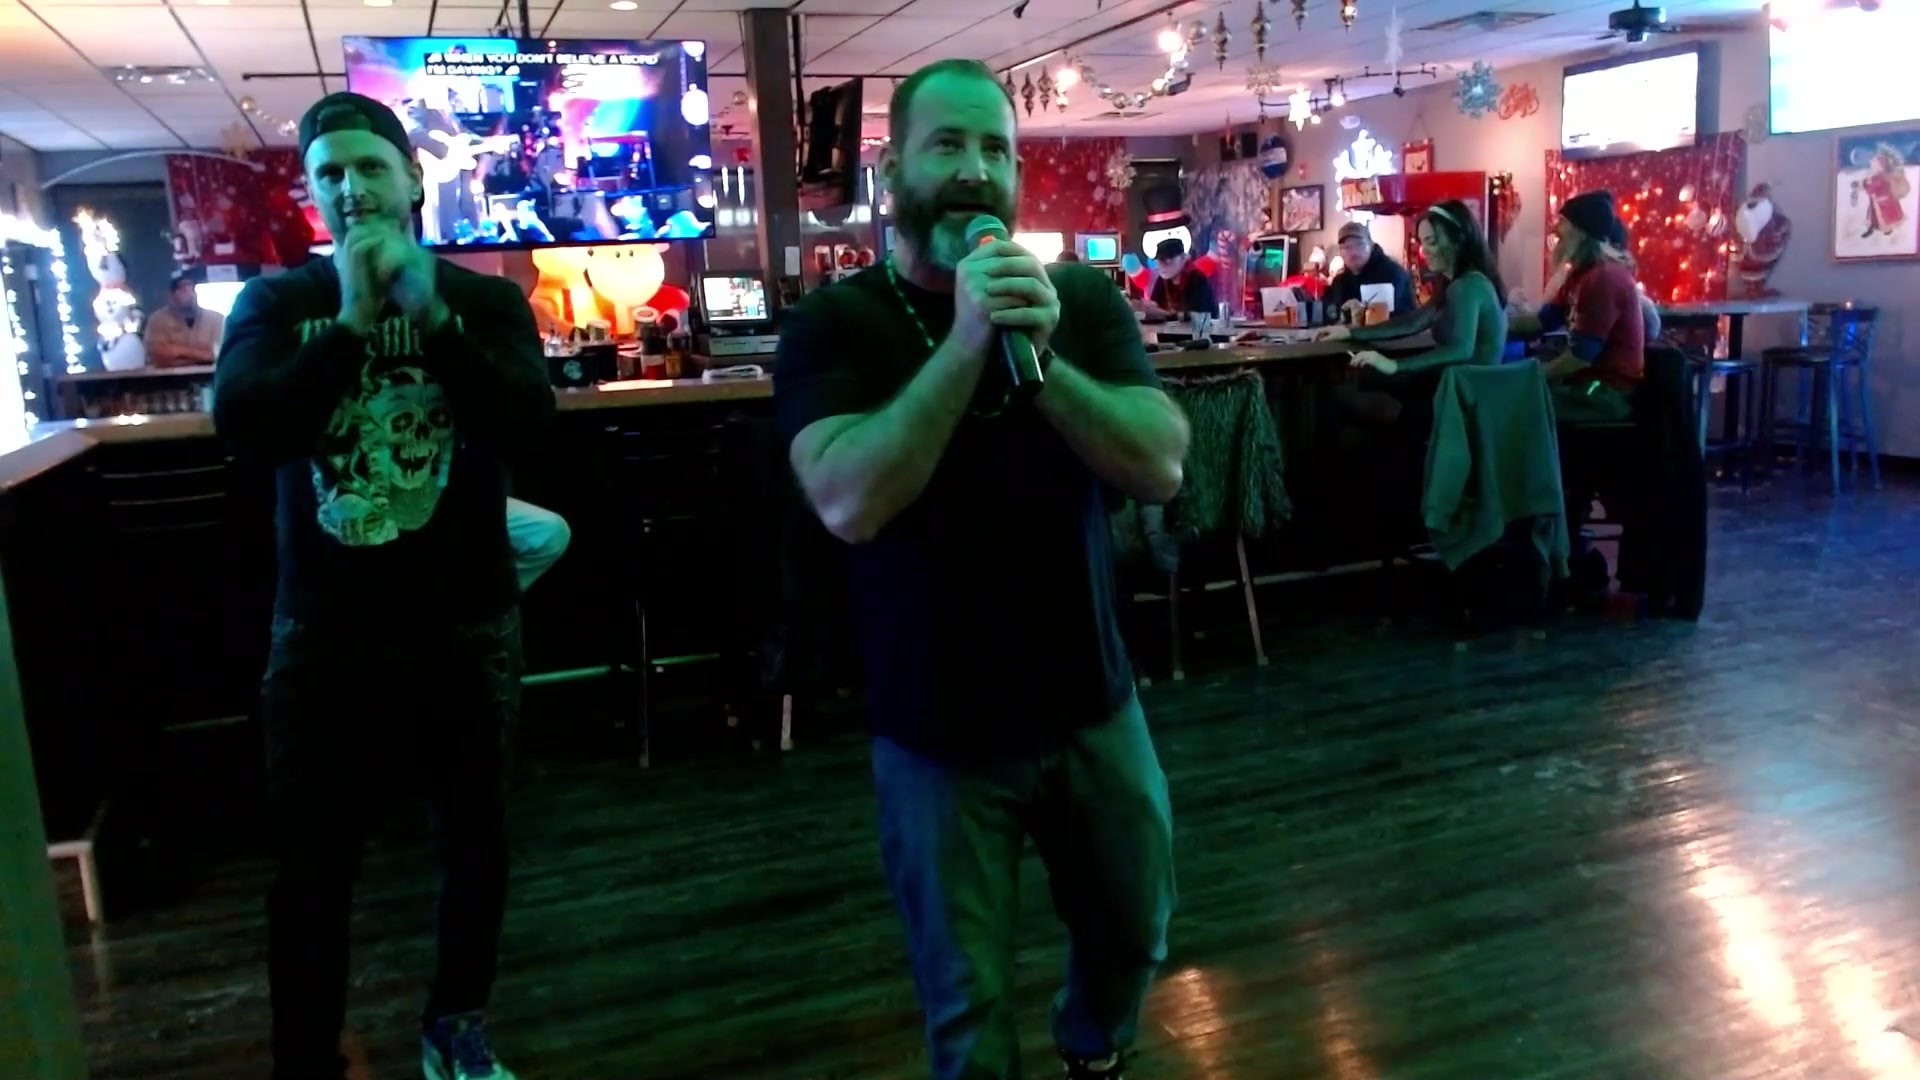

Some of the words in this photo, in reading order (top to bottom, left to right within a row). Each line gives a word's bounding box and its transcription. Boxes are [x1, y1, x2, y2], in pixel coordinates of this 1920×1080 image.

[486, 53, 515, 63] YOU
[556, 54, 605, 64] BELIEVE
[609, 54, 619, 64] A
